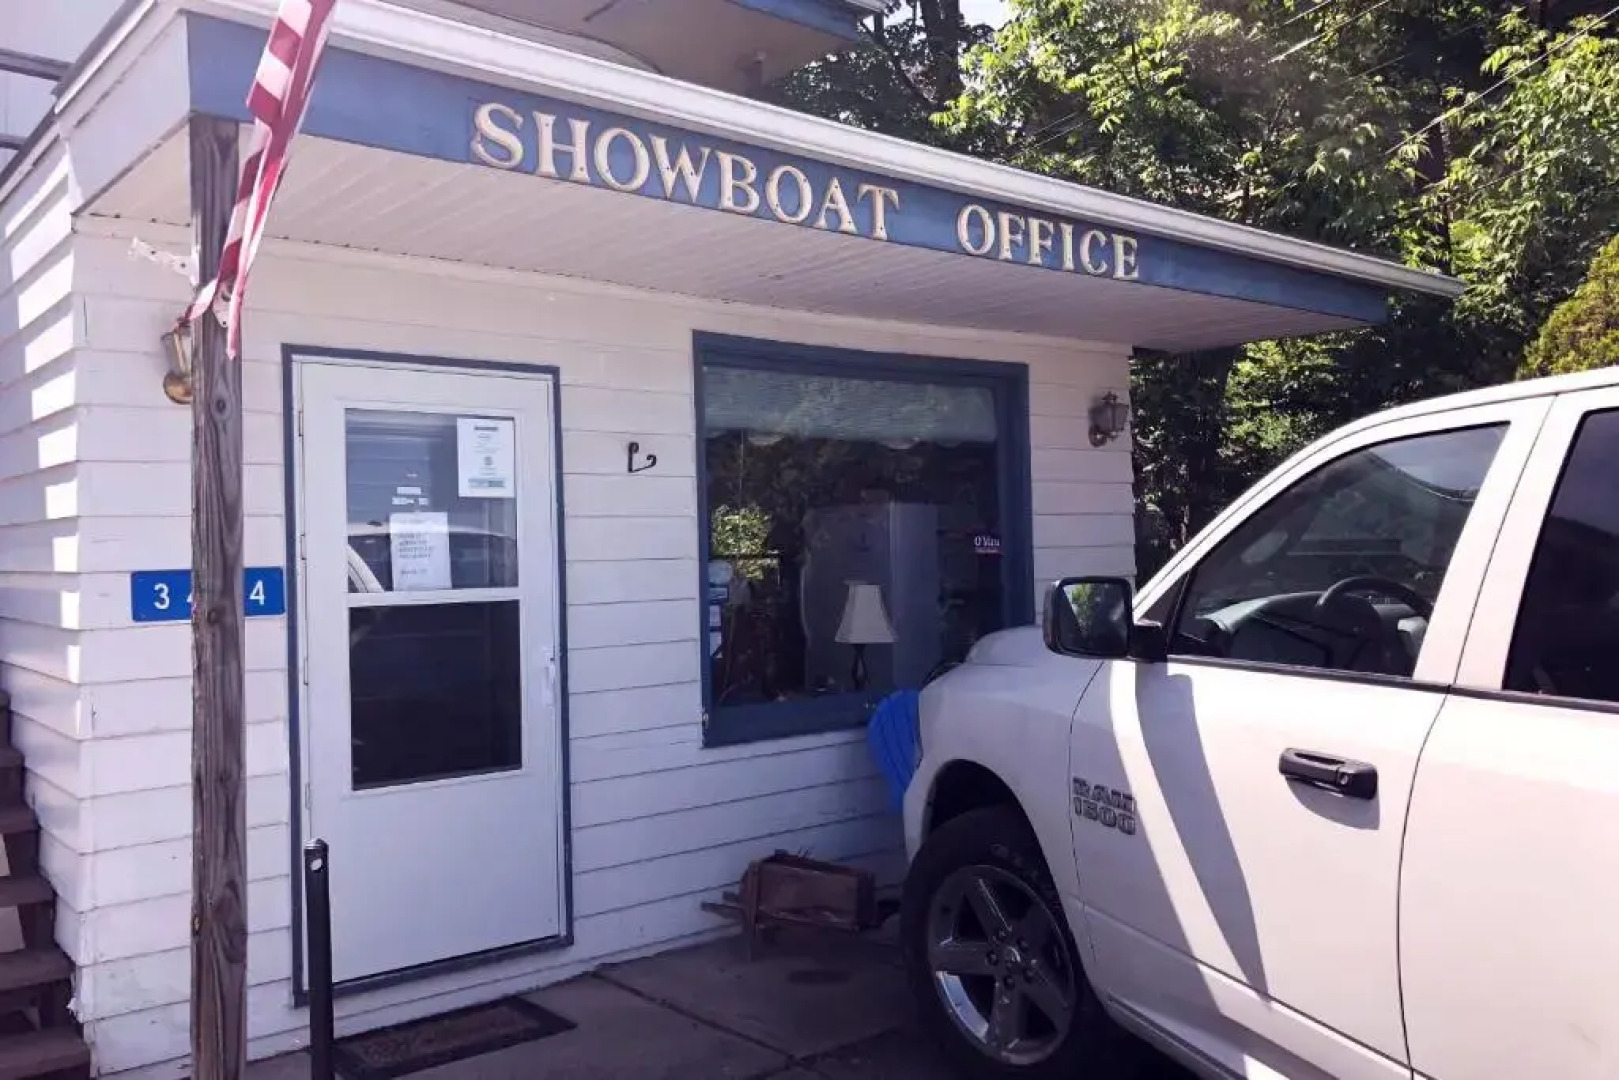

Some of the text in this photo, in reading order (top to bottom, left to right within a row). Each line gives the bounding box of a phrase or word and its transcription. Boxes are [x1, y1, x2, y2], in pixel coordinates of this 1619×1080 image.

[471, 102, 1139, 281] SHOWBOAT OFFICE
[1073, 797, 1136, 836] 1500
